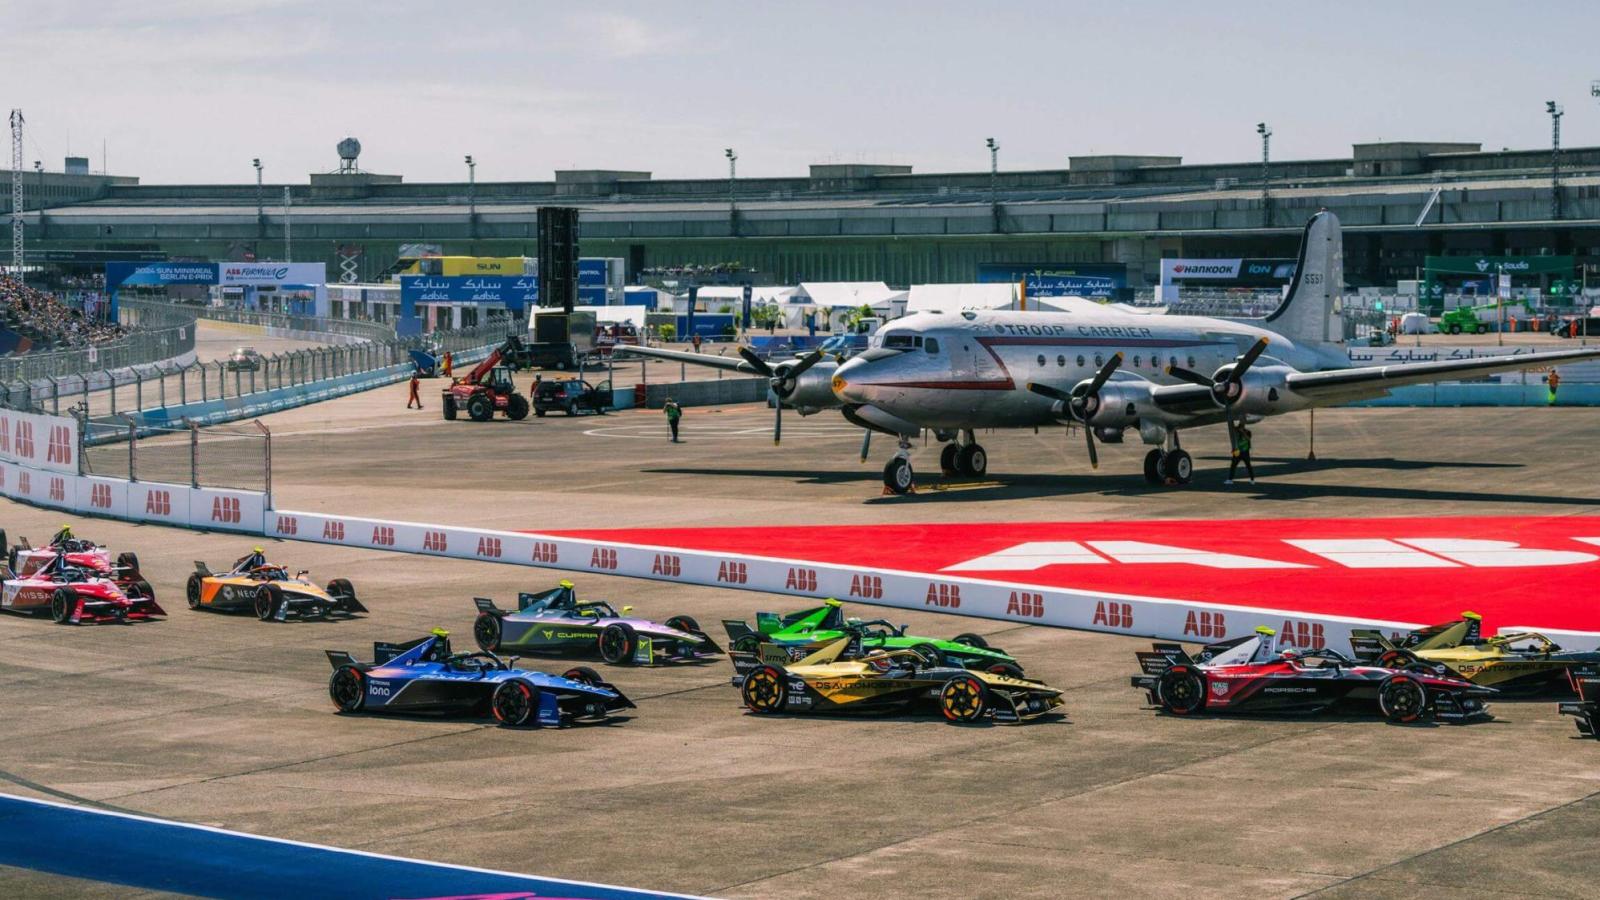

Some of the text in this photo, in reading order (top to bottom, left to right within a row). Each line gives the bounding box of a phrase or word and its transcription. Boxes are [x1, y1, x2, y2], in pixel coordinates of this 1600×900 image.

[1005, 324, 1153, 338] TROOP CARRIER
[0, 416, 72, 464] BB ABB ABB
[936, 537, 1600, 571] AB
[18, 471, 31, 495] ABB
[49, 477, 65, 501] ABB
[90, 483, 112, 508] ABB
[146, 489, 171, 516] ABB
[211, 496, 241, 524] ABB
[276, 516, 297, 535] ABB
[322, 521, 345, 541] ABB
[371, 526, 395, 546] ABB
[423, 531, 447, 552] ABB
[476, 536, 502, 558] ABB
[532, 541, 558, 564] ABB
[590, 547, 618, 570] ABB
[652, 554, 681, 577] ABB
[718, 560, 748, 584] ABB
[786, 568, 817, 592] ABB
[850, 574, 883, 599] ABB
[926, 583, 961, 609] ABB
[1006, 590, 1045, 618] ABB
[1092, 600, 1134, 629] ABB
[1184, 610, 1226, 639] ABB
[1279, 620, 1326, 650] ABB
[19, 592, 54, 600] NISSA
[237, 590, 257, 599] NEO
[1458, 665, 1475, 673] DS
[815, 681, 831, 689] DS
